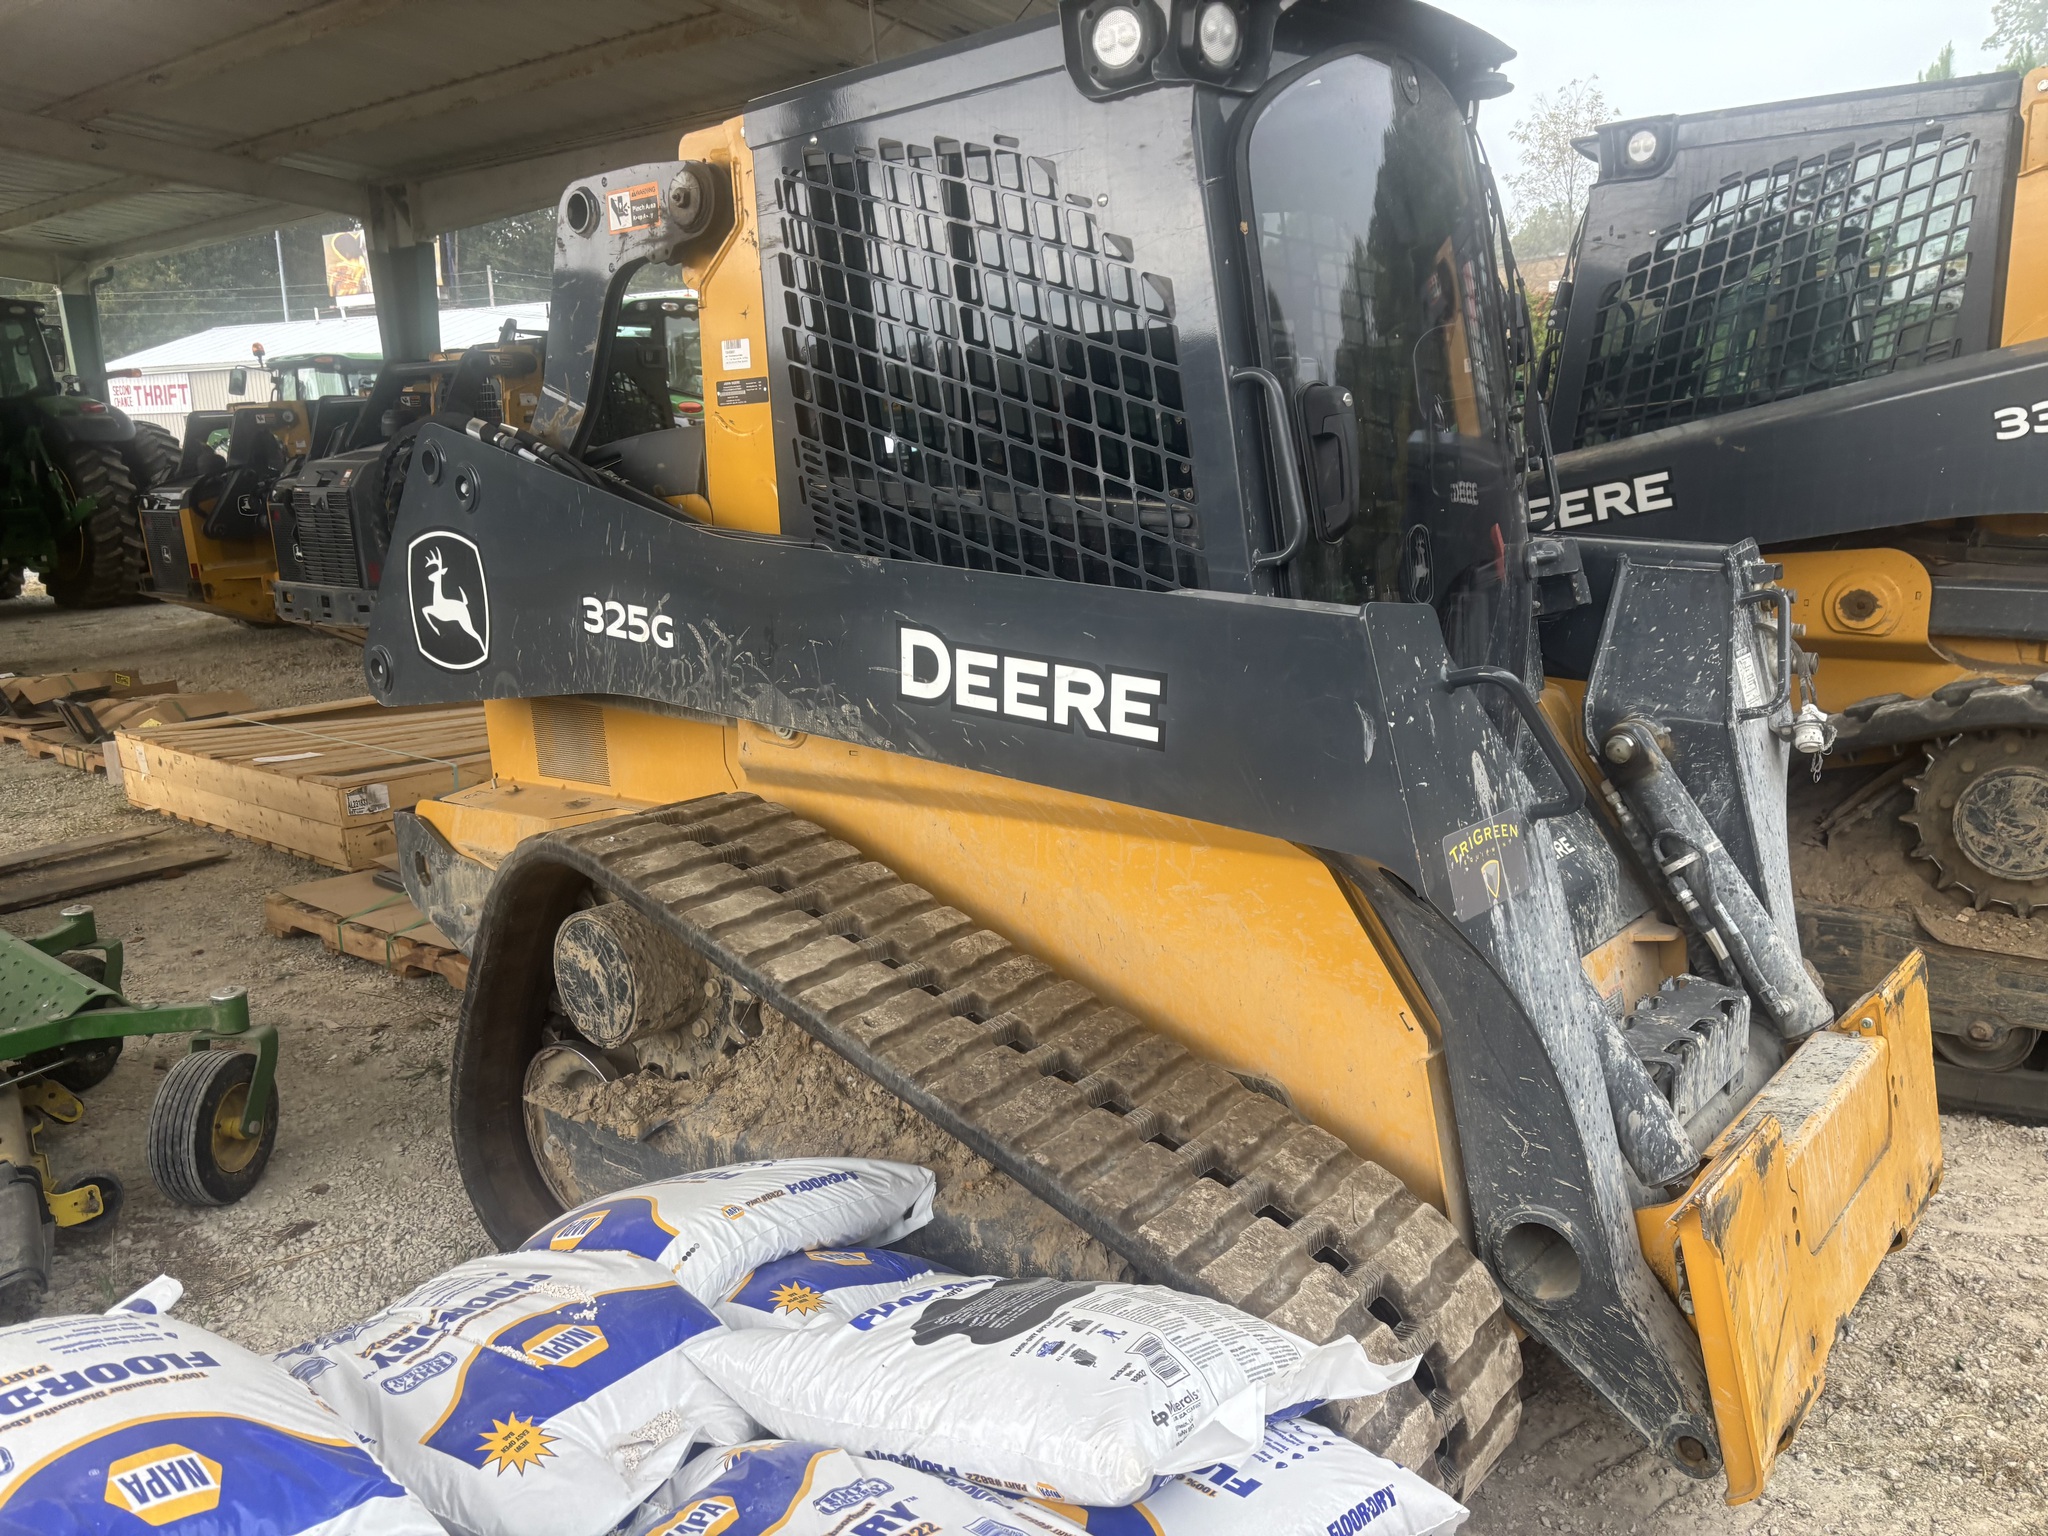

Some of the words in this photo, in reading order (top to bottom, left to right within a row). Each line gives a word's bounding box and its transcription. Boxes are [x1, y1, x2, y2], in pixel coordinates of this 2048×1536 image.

[112, 384, 132, 397] SECOND
[114, 396, 134, 408] CHANCE
[133, 383, 189, 407] THRIFT
[582, 596, 675, 649] 325G
[900, 626, 1162, 743] DEERE
[532, 1328, 598, 1360] NAPA
[110, 1376, 169, 1395] Granular
[170, 1371, 209, 1385] 100%
[33, 1391, 109, 1419] Diatomite
[0, 1415, 32, 1433] Abs
[117, 1457, 211, 1505] NAPA
[1326, 1486, 1397, 1536] FLOOR-DRY
